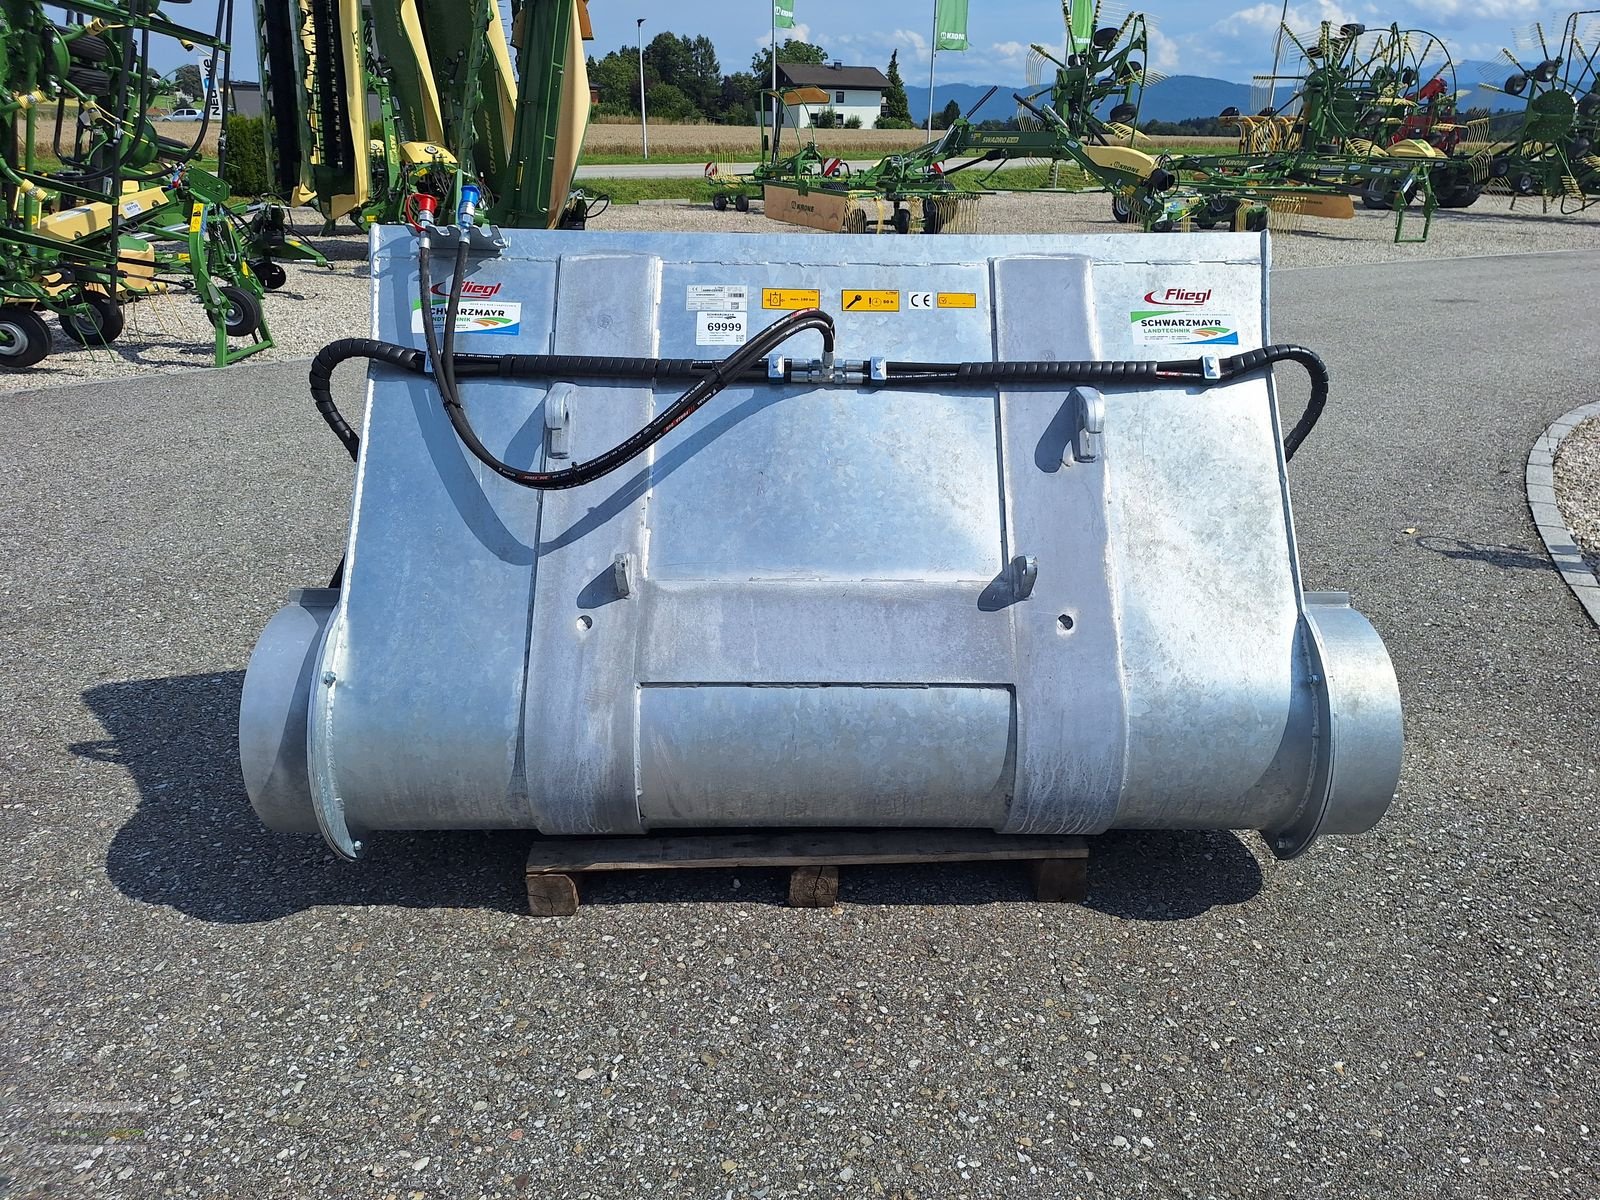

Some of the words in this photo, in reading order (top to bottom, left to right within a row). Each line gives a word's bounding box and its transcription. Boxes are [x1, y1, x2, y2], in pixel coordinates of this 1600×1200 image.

[461, 281, 501, 296] liegl
[911, 294, 930, 307] CE
[1165, 289, 1212, 303] Fliegl
[707, 322, 742, 332] 69999
[1141, 319, 1222, 327] SCHWARZMAYR
